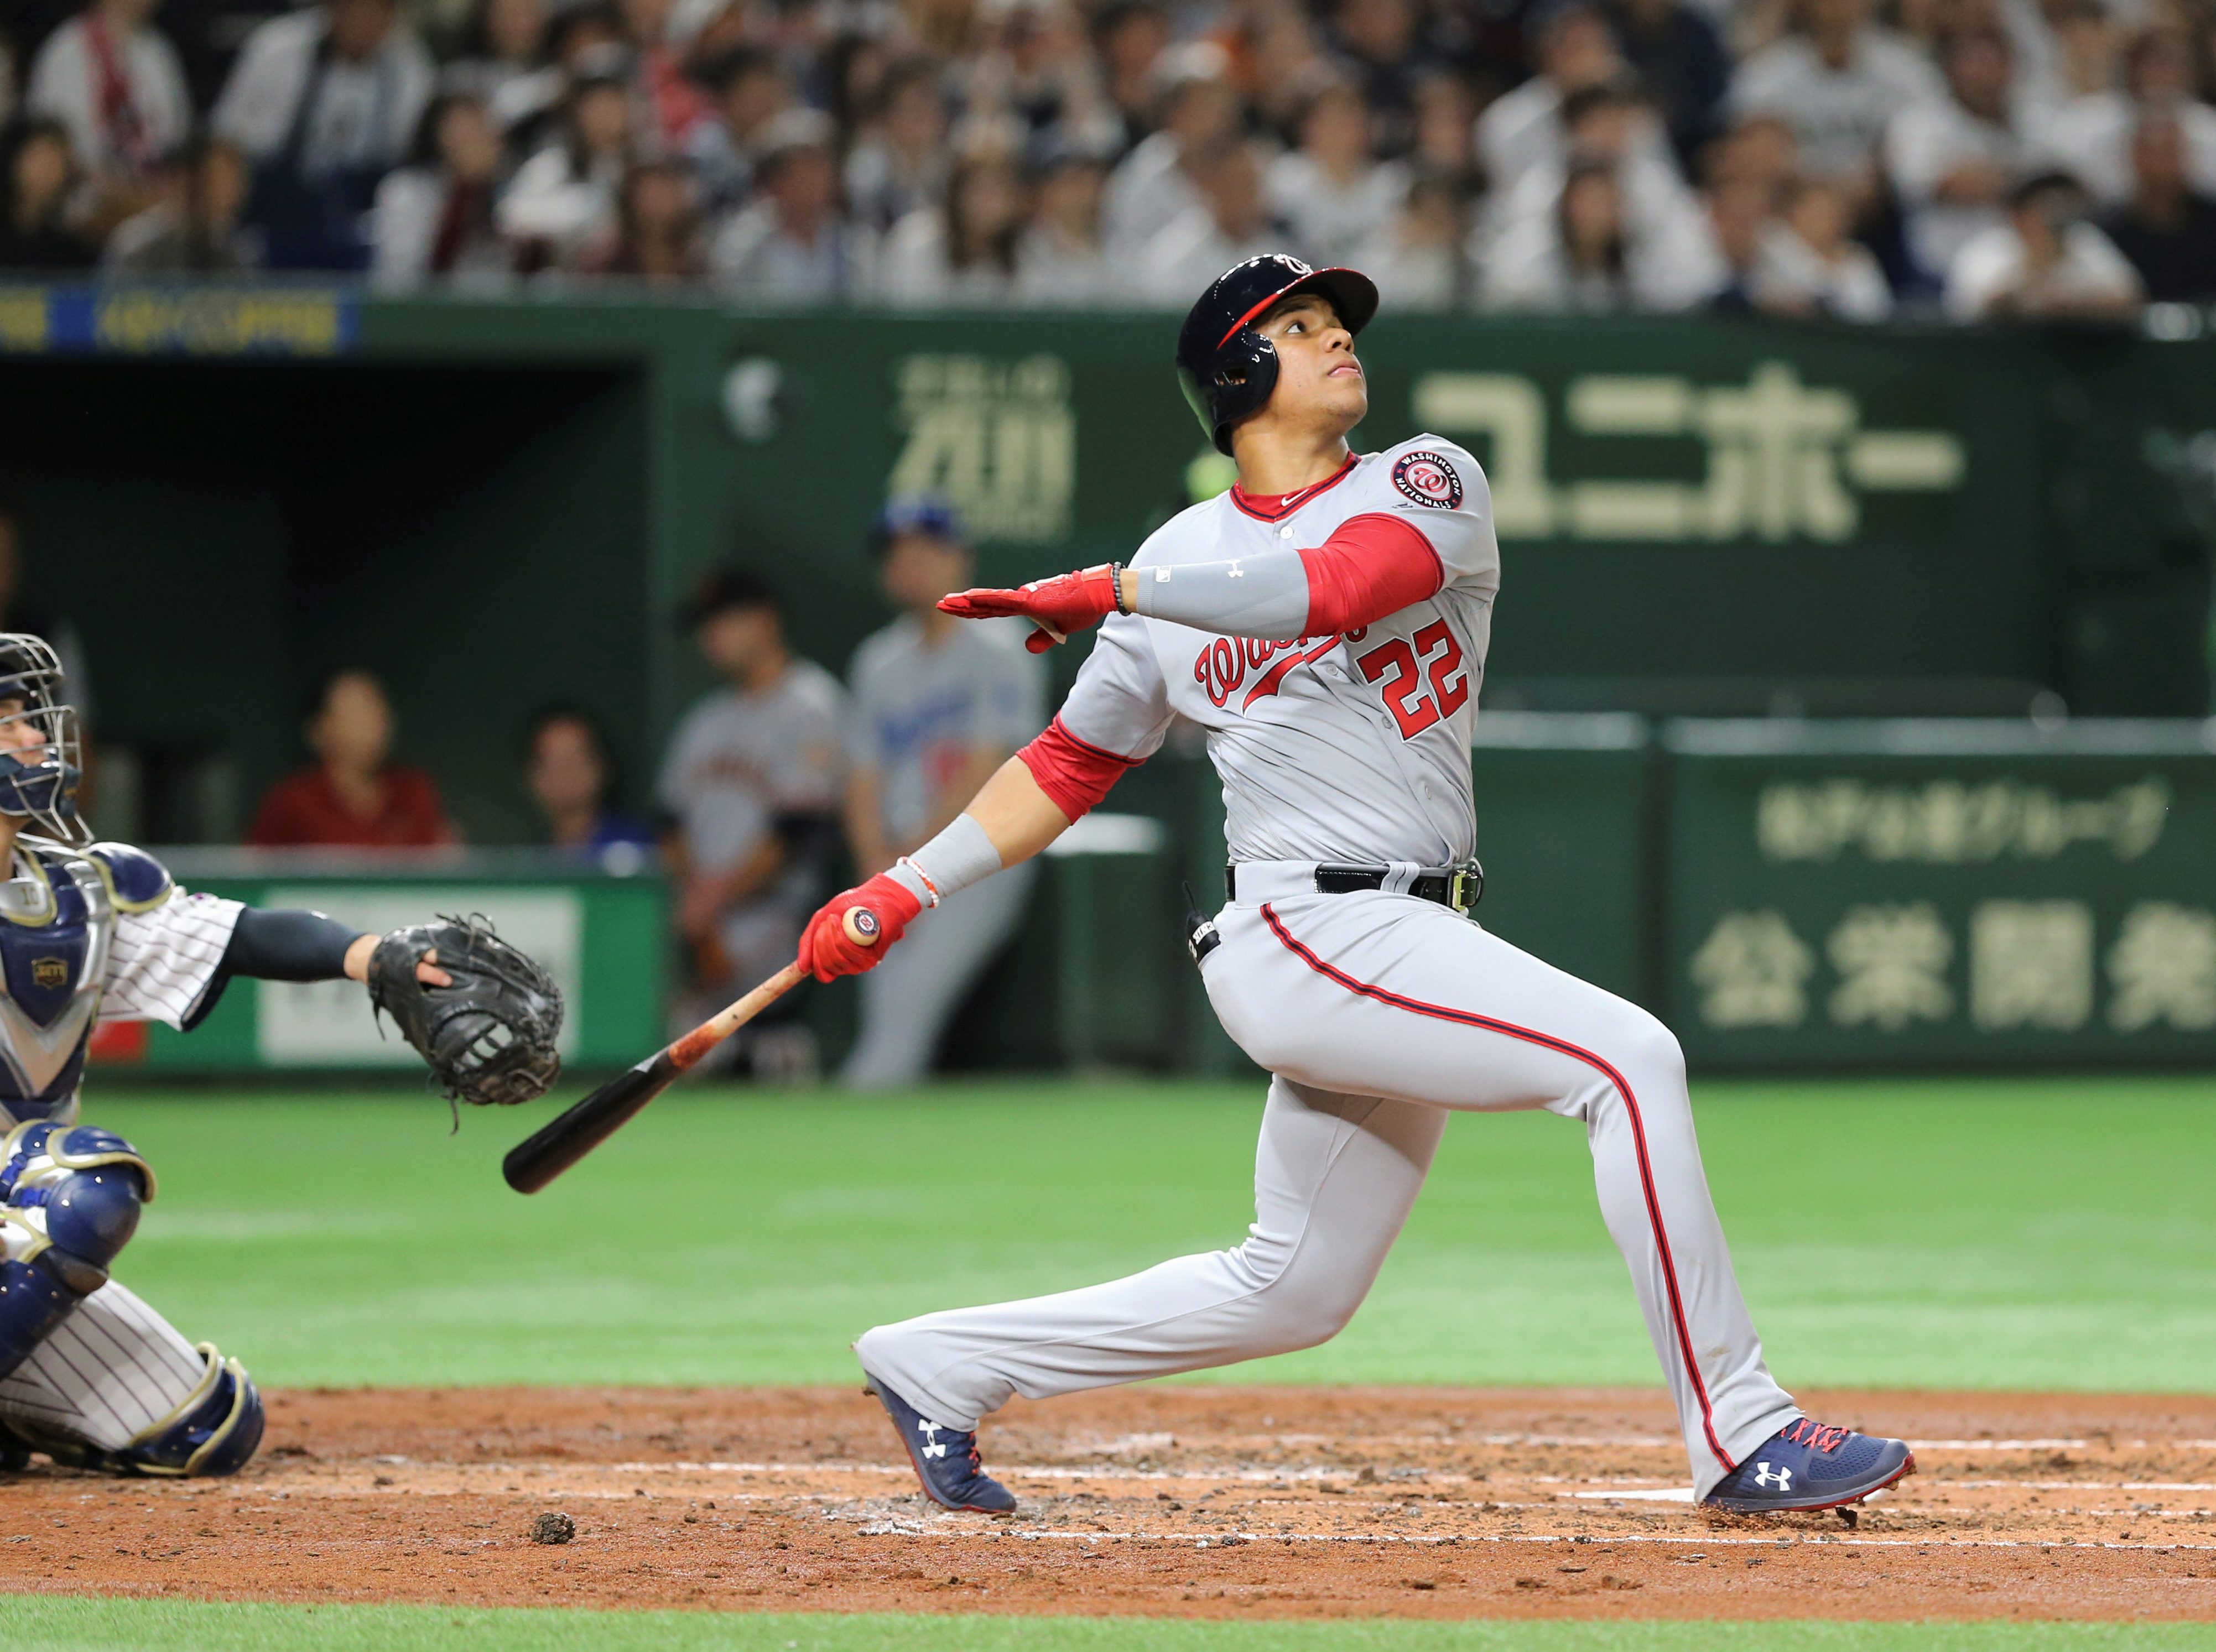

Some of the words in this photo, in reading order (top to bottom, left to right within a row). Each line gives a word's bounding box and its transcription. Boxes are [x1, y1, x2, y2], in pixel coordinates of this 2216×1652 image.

[1395, 477, 1452, 509] NATIONALS
[1401, 452, 1461, 496] WASHINGTON
[1355, 616, 1469, 743] 22
